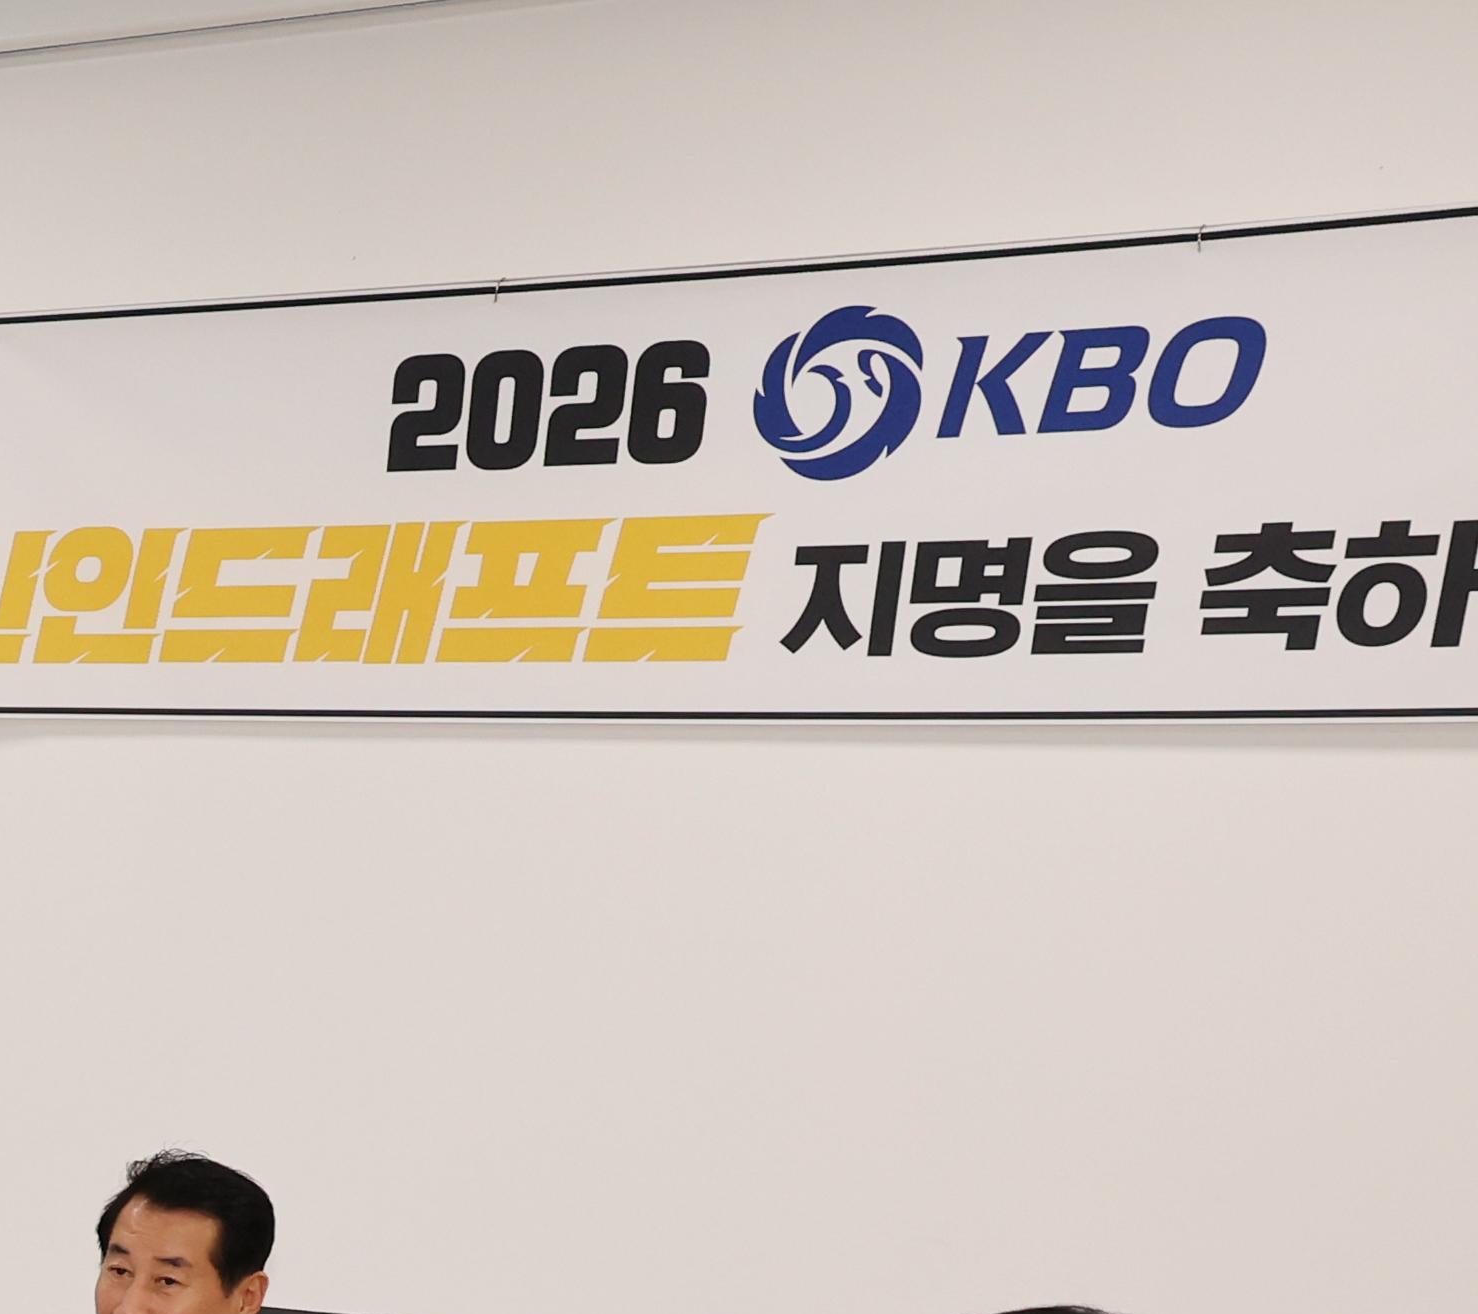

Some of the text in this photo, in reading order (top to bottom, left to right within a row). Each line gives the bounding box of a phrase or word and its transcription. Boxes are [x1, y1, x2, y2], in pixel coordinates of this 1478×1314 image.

[387, 316, 1266, 473] 2026 KBO
[777, 530, 1161, 658] 지명을
[1200, 520, 1478, 650] 축하
